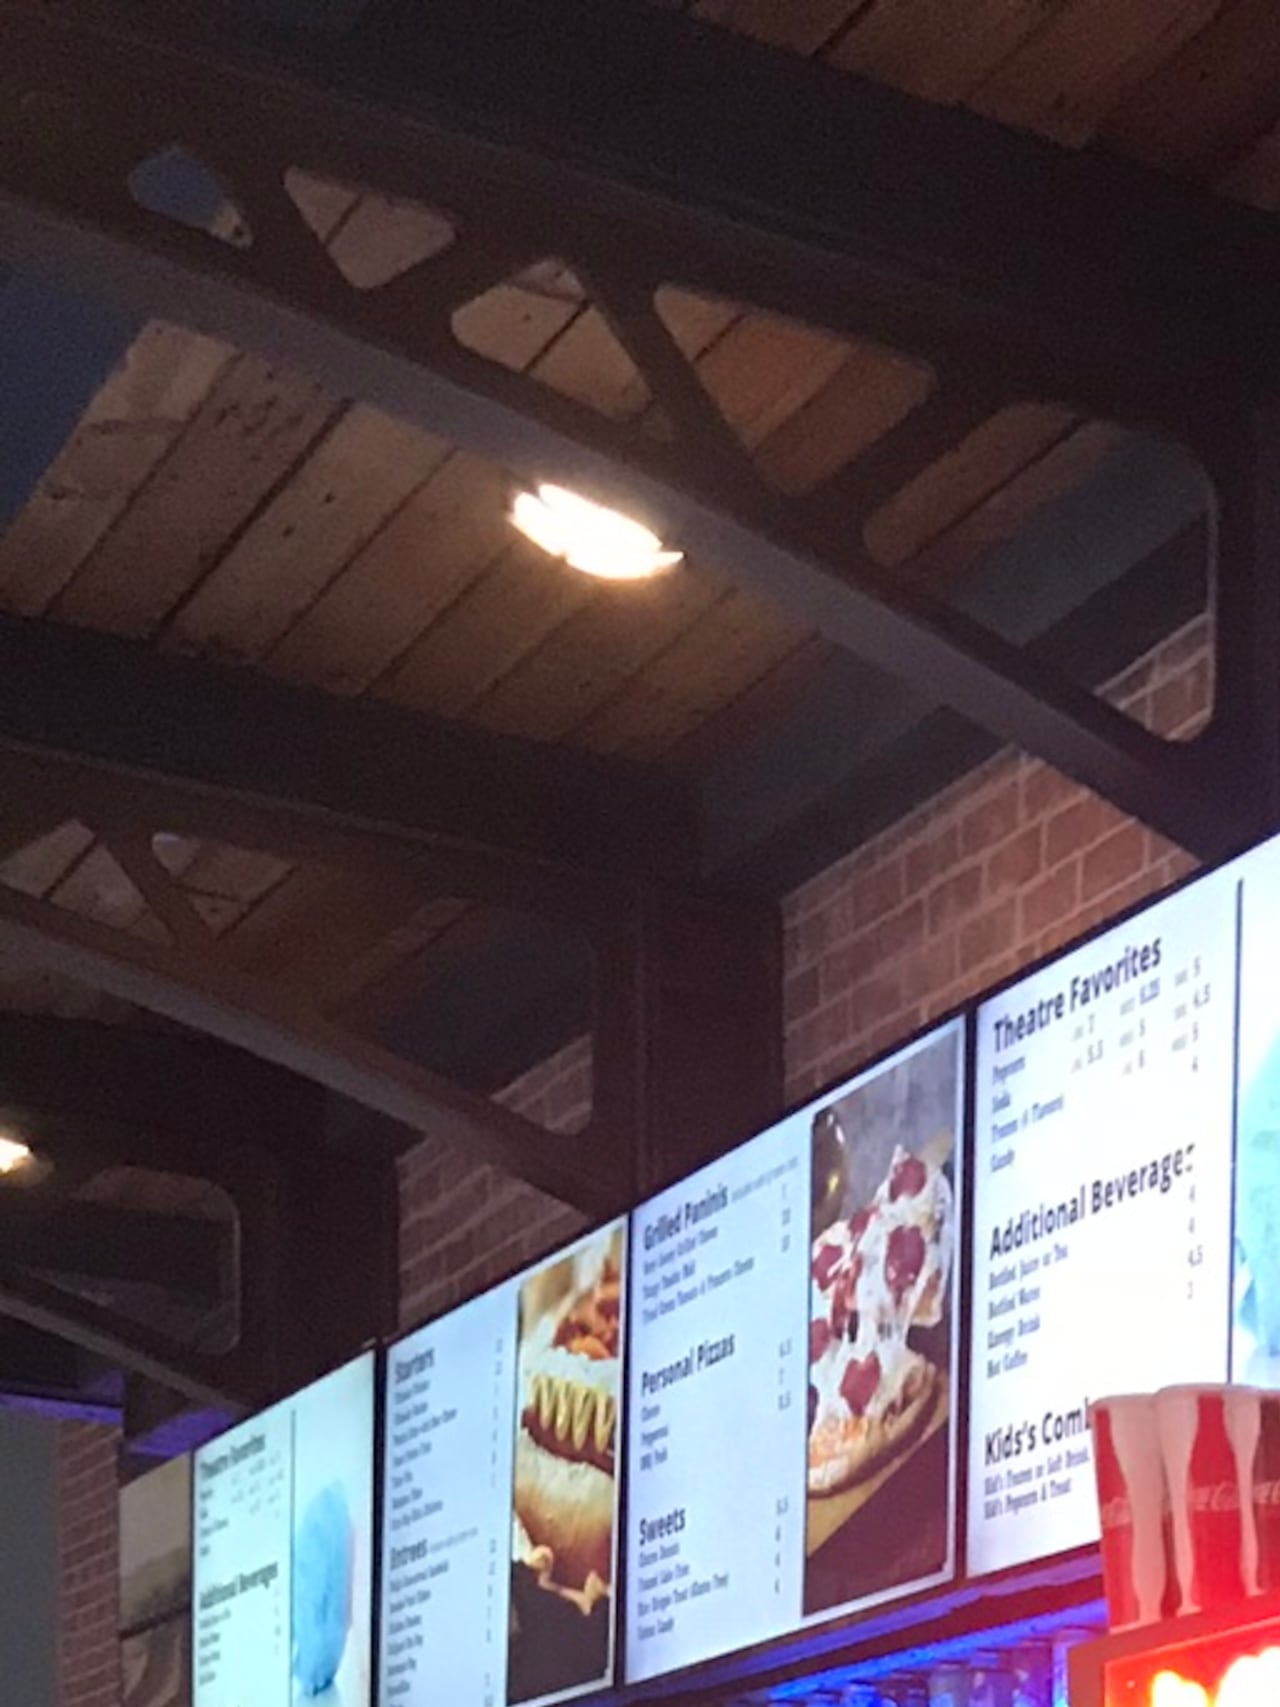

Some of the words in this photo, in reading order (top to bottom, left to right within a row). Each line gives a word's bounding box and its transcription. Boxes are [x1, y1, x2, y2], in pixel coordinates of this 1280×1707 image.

[992, 991, 1066, 1053] Theatre
[1069, 936, 1163, 1014] Favorites
[644, 1205, 683, 1251] Grilled
[989, 1183, 1087, 1261] Additional
[641, 1346, 694, 1398] Personal
[697, 1333, 735, 1373] Pizzas
[639, 1507, 686, 1547] Sweets
